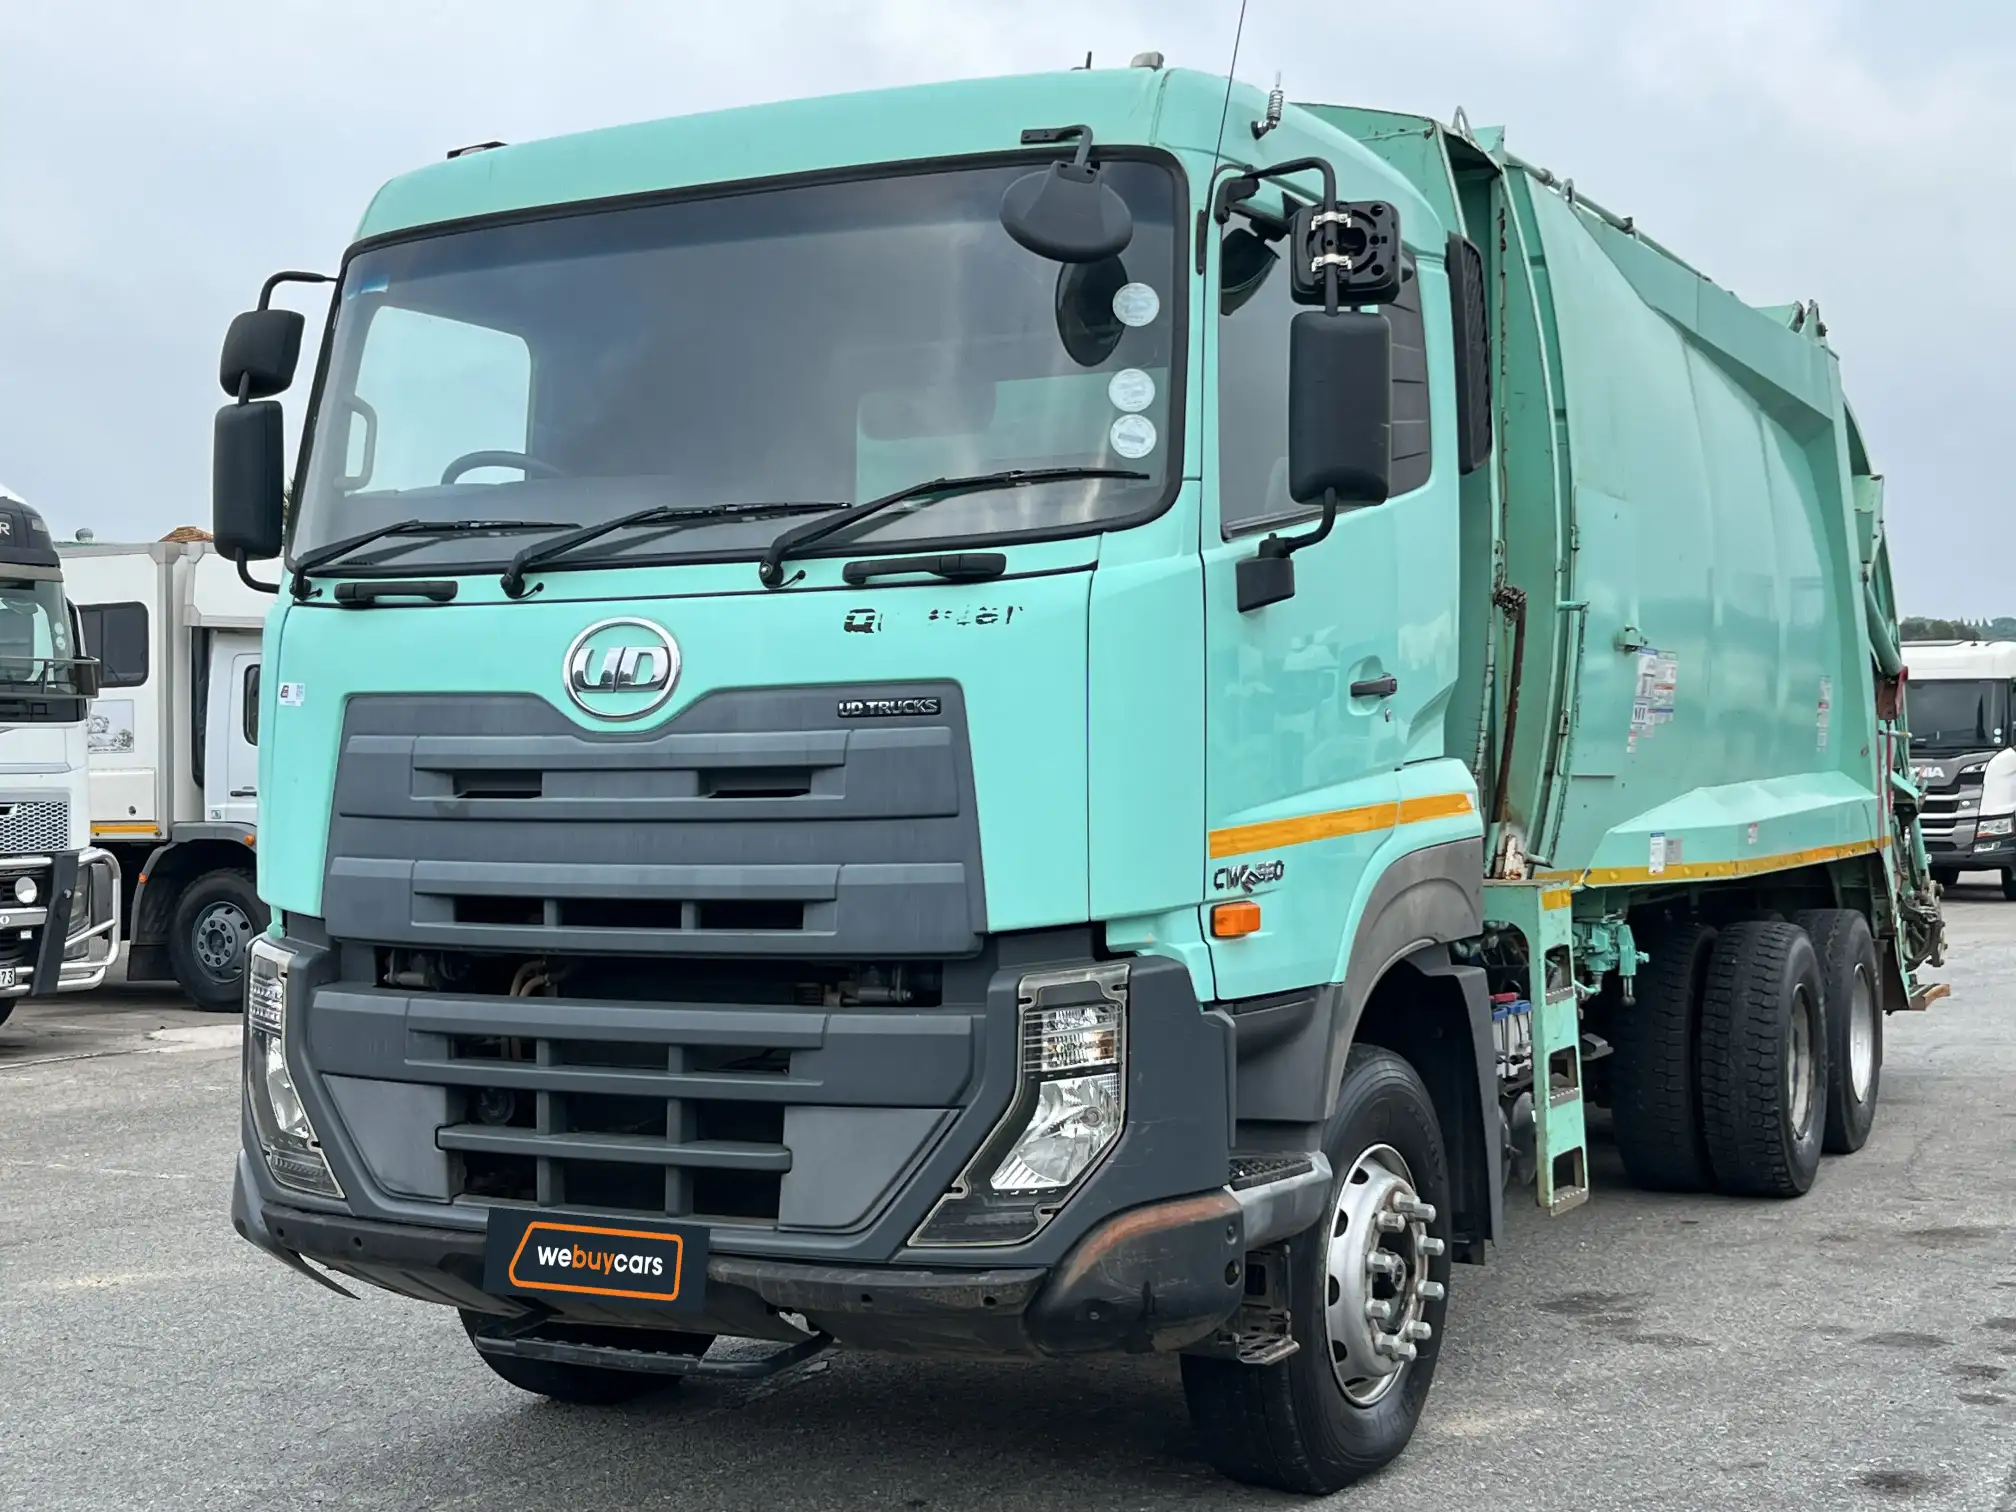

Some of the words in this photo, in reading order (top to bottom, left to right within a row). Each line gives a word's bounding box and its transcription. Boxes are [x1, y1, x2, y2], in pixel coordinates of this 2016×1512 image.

[571, 646, 671, 693] UD
[838, 702, 863, 716] UD
[866, 699, 938, 715] TRUCKS
[537, 1244, 663, 1276] webuycars
